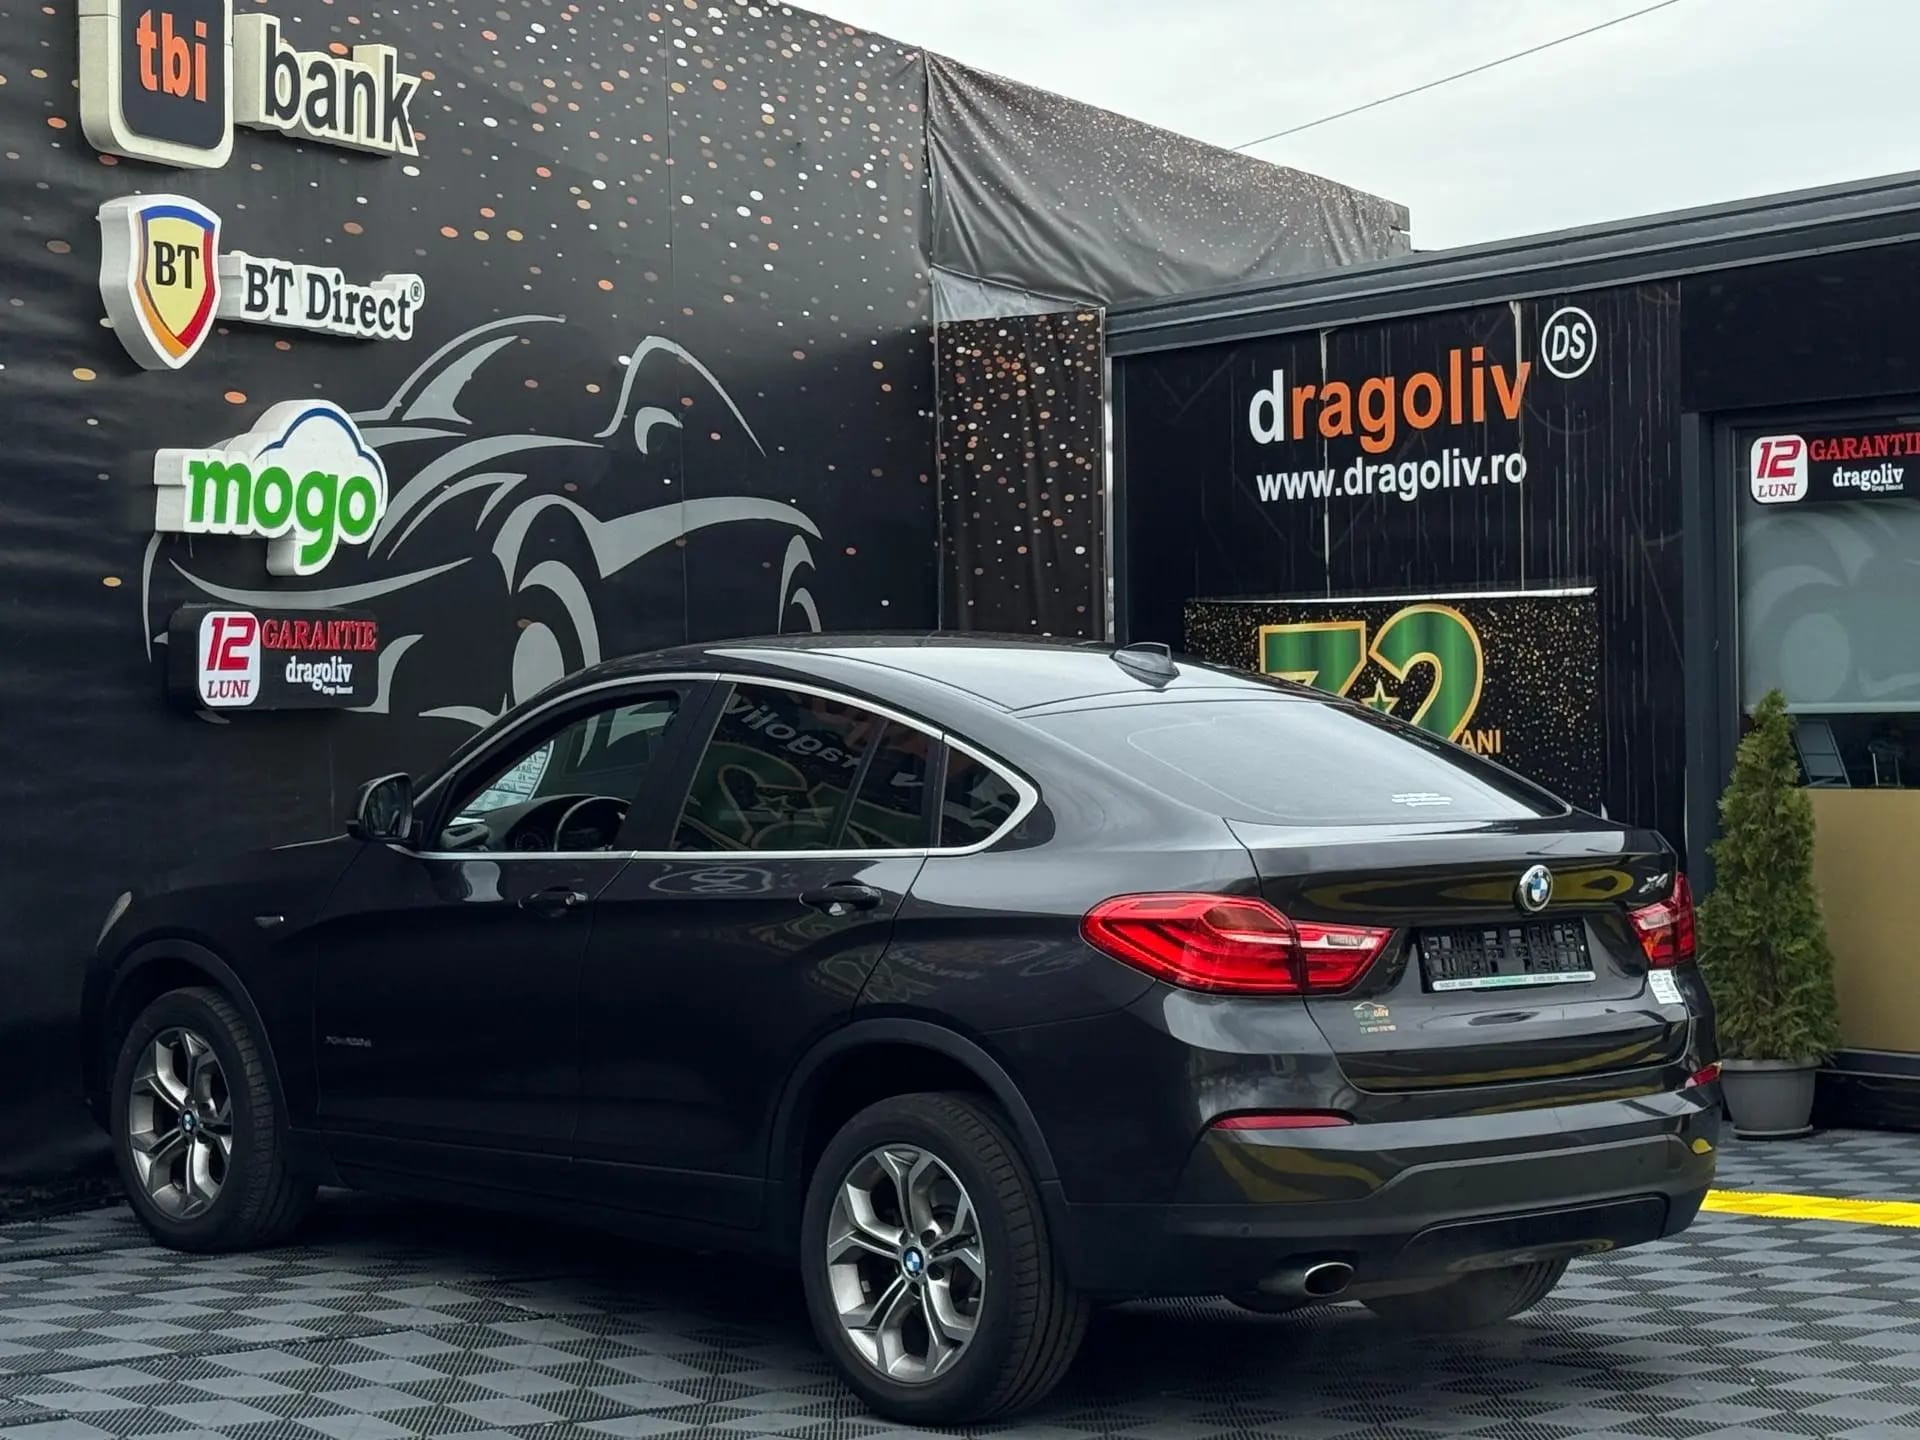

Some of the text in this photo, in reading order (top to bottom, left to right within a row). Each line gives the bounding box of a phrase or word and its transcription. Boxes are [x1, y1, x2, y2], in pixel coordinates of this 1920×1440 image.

[136, 9, 208, 102] tbi
[265, 23, 417, 150] bank
[153, 240, 200, 290] BT
[245, 263, 294, 316] BT
[1550, 321, 1588, 363] DS
[1248, 345, 1531, 455] dragoliv
[1256, 447, 1527, 503] www.dragoliv.ro
[1756, 439, 1802, 479] 12
[1832, 462, 1905, 491] dragoliv
[188, 459, 377, 566] mogo
[1757, 483, 1797, 498] LUNI
[205, 616, 257, 672] 12
[261, 618, 378, 651] GARANTIE
[206, 679, 252, 699] LUNI
[285, 655, 353, 692] dragoliv
[1459, 729, 1501, 754] ANI
